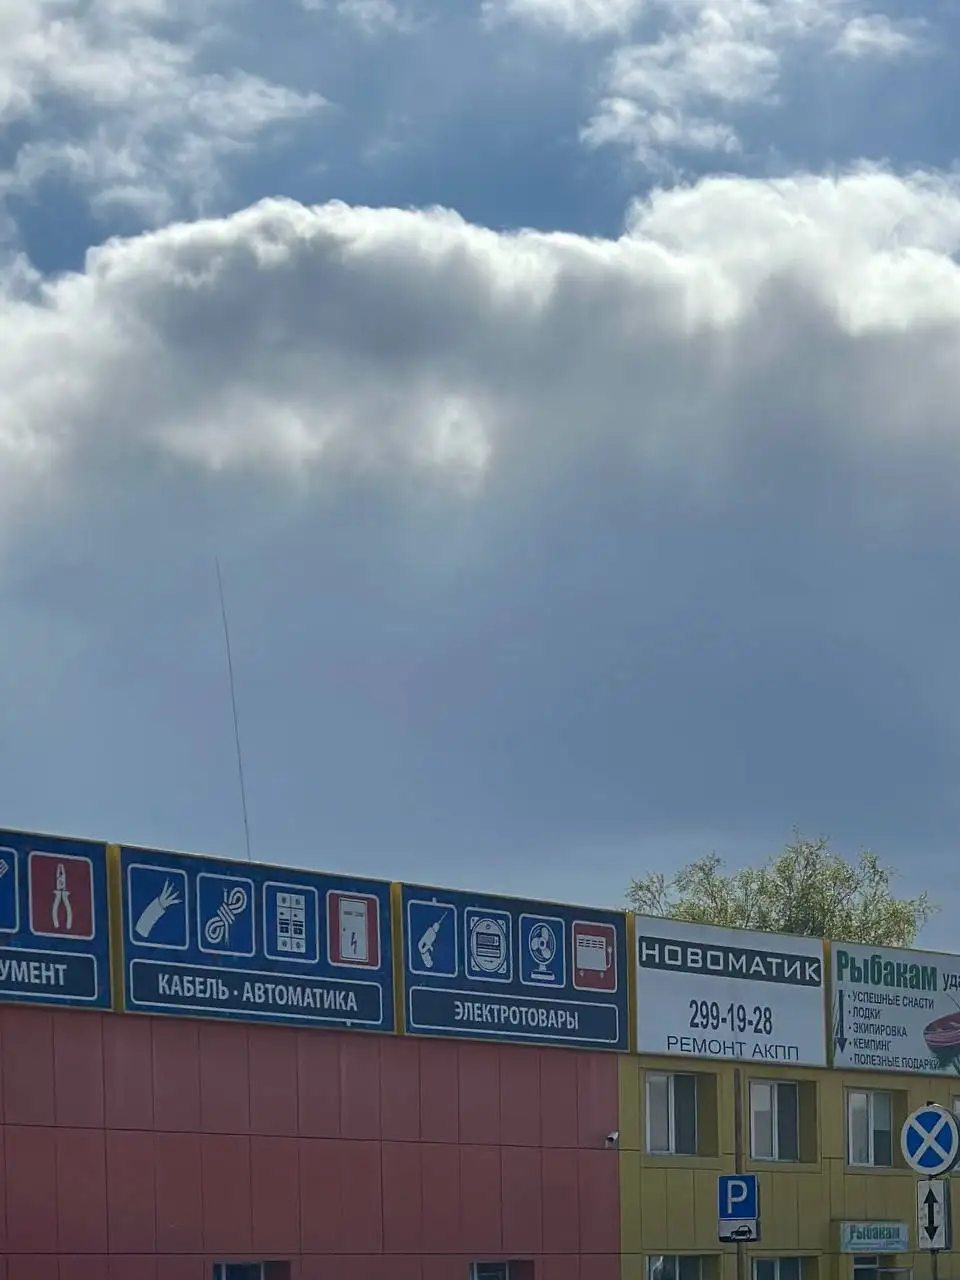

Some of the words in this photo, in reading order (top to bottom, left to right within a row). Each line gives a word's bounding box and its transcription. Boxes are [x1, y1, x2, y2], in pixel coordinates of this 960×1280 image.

[0, 959, 68, 986] УМЕНТ
[641, 941, 821, 982] НОВОМАТИК
[836, 949, 938, 991] Рыбакам
[157, 973, 230, 1000] КАБЕЛЬ
[241, 981, 359, 1012] АВТОМАТИКА
[852, 991, 900, 1007] УСПЕШНЫЕ
[902, 996, 935, 1010] СНАСТИ
[453, 1000, 580, 1030] ЭЛЕКТРОТОВАРЫ
[689, 999, 773, 1036] 299-19-28
[852, 1006, 881, 1021] ЛОДКИ
[853, 1022, 908, 1037] ЭКИПИРОВКА
[667, 1035, 746, 1057] РЕМОНТ
[751, 1043, 800, 1061] АКПП
[853, 1038, 892, 1051] КЕМПИНГ
[853, 1053, 901, 1069] ПОЛЕЗНЫЕ
